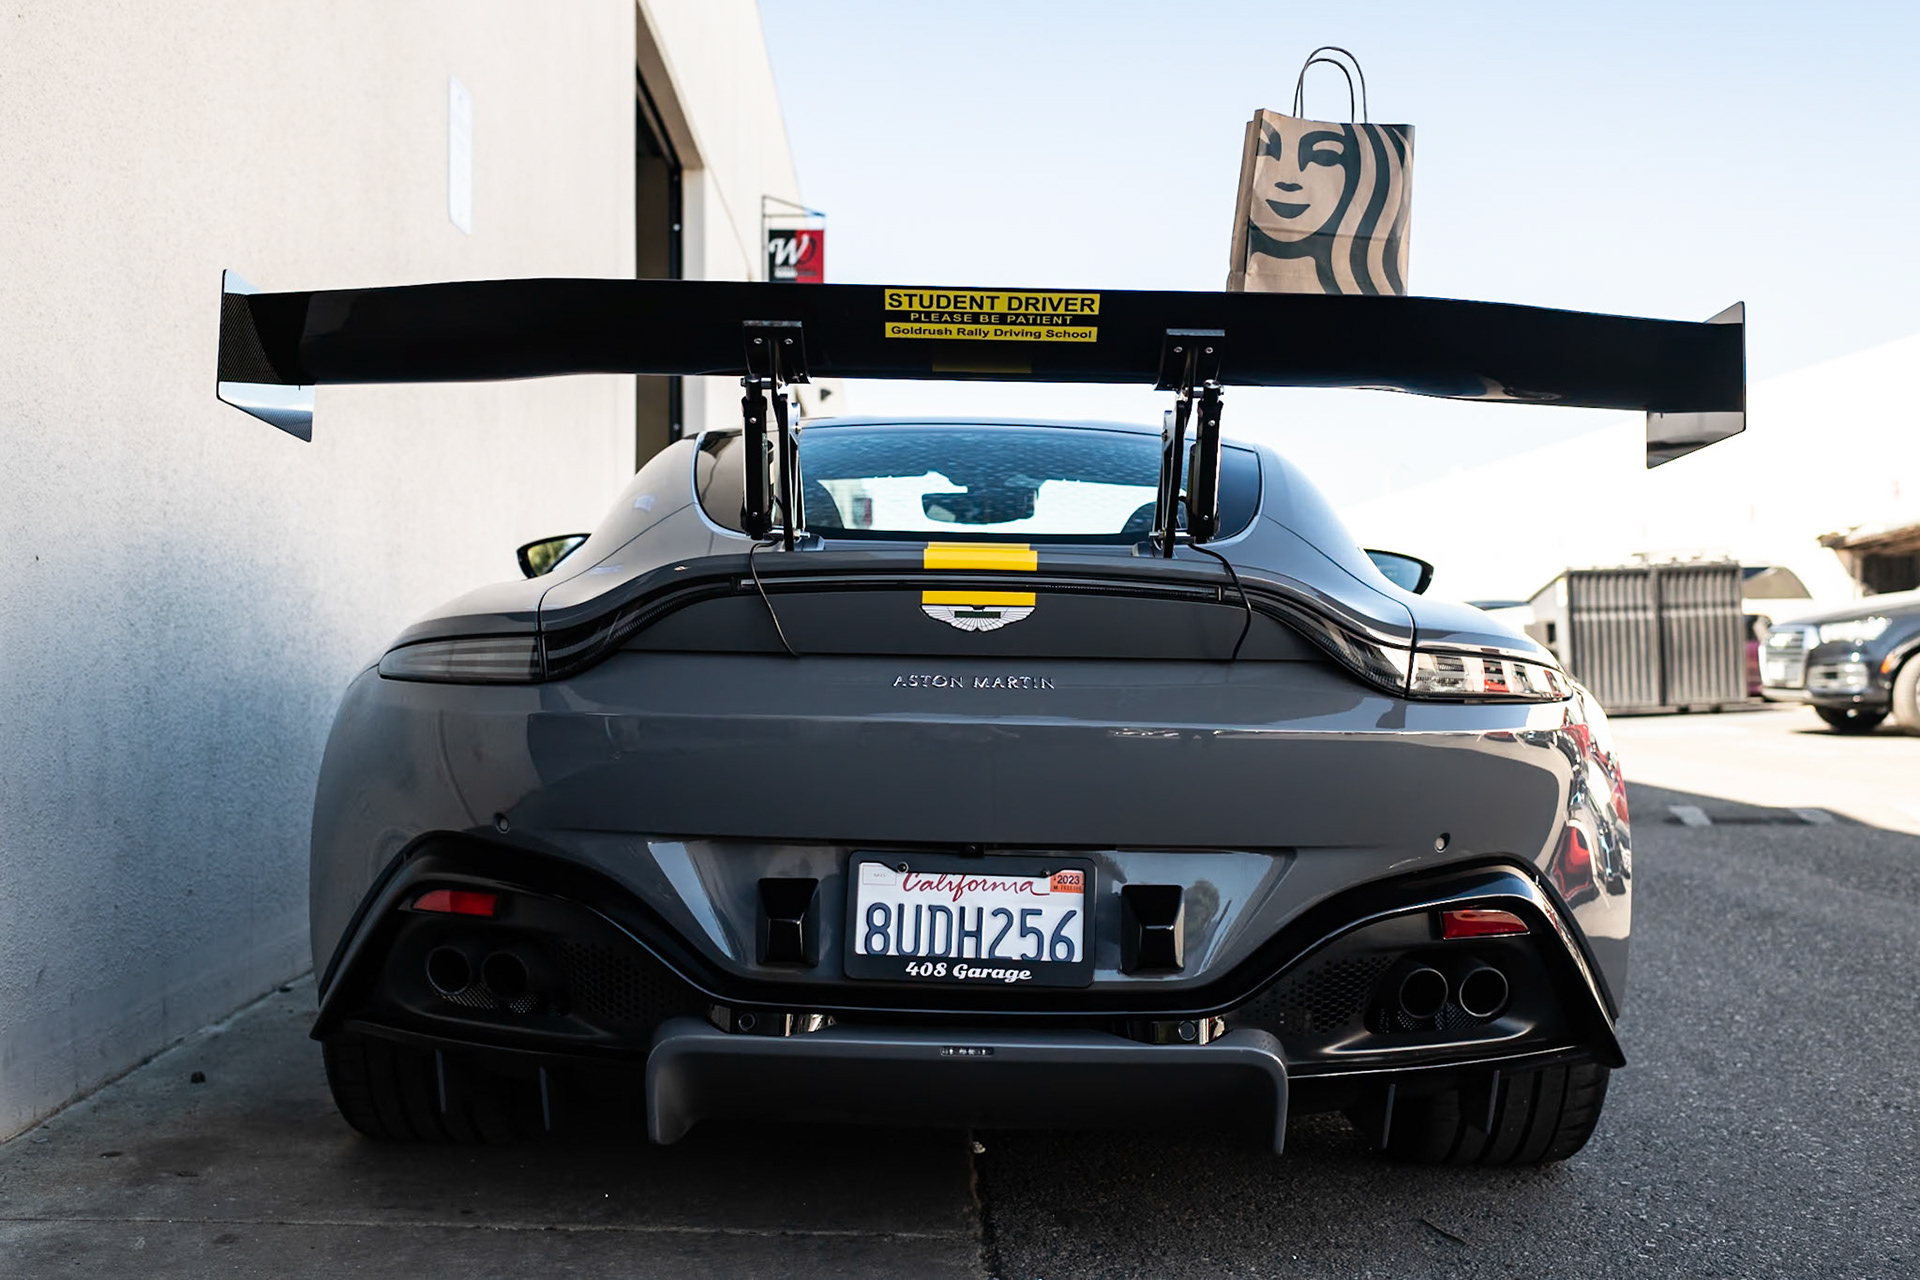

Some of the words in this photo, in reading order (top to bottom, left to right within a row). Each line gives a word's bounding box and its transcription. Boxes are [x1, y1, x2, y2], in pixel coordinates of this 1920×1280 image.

[888, 293, 1000, 311] STUDENT
[1007, 296, 1095, 313] DRIVER
[910, 313, 973, 323] PLEASE
[979, 314, 1000, 323] BE
[1007, 315, 1073, 325] PATIENT
[891, 326, 952, 336] Goldrush
[957, 327, 989, 338] Rally
[994, 328, 1042, 339] Driving
[1046, 330, 1092, 339] School
[893, 675, 964, 688] ASTON
[973, 676, 1055, 690] MARTIN
[902, 872, 1050, 902] California
[1057, 874, 1081, 885] 2023
[864, 902, 1078, 963] 8UDH256
[905, 961, 948, 977] 408
[952, 963, 1032, 983] Garage
